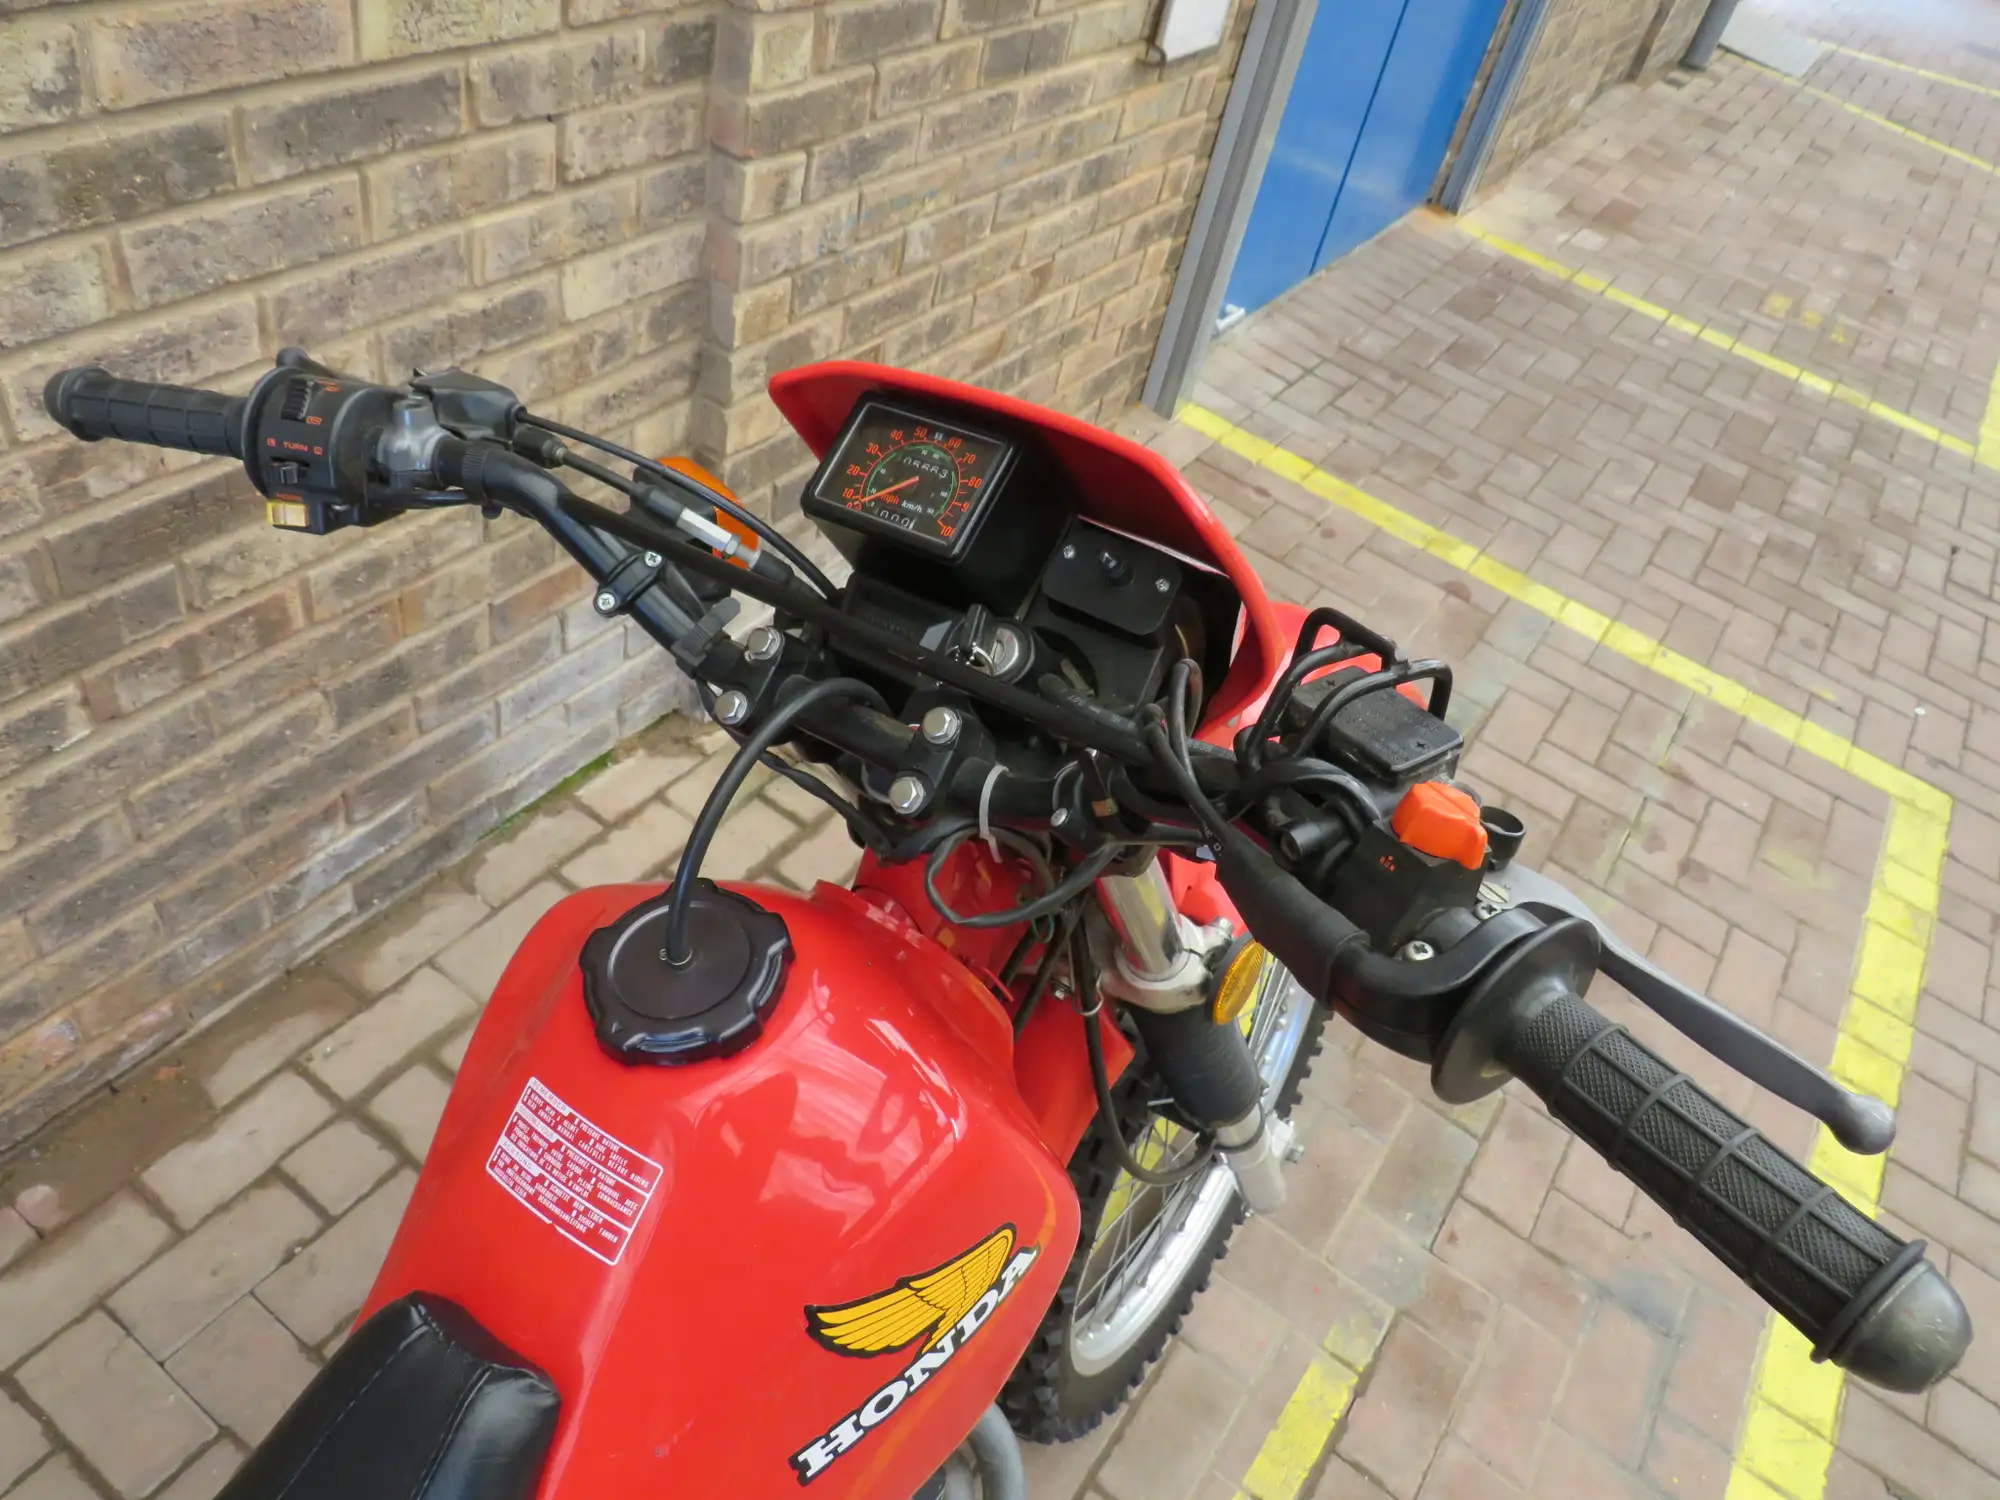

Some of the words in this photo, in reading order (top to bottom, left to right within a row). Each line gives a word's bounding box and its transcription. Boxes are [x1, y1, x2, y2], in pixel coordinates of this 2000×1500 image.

[890, 429, 903, 440] 40
[914, 427, 927, 438] 50
[866, 443, 879, 454] 30
[949, 438, 962, 448] 60
[962, 452, 976, 463] 70
[847, 465, 859, 476] 20
[968, 477, 982, 489] 80
[842, 488, 854, 499] 10
[881, 493, 900, 505] mph
[902, 500, 922, 513] km/h
[798, 1249, 1036, 1477] HONDA
